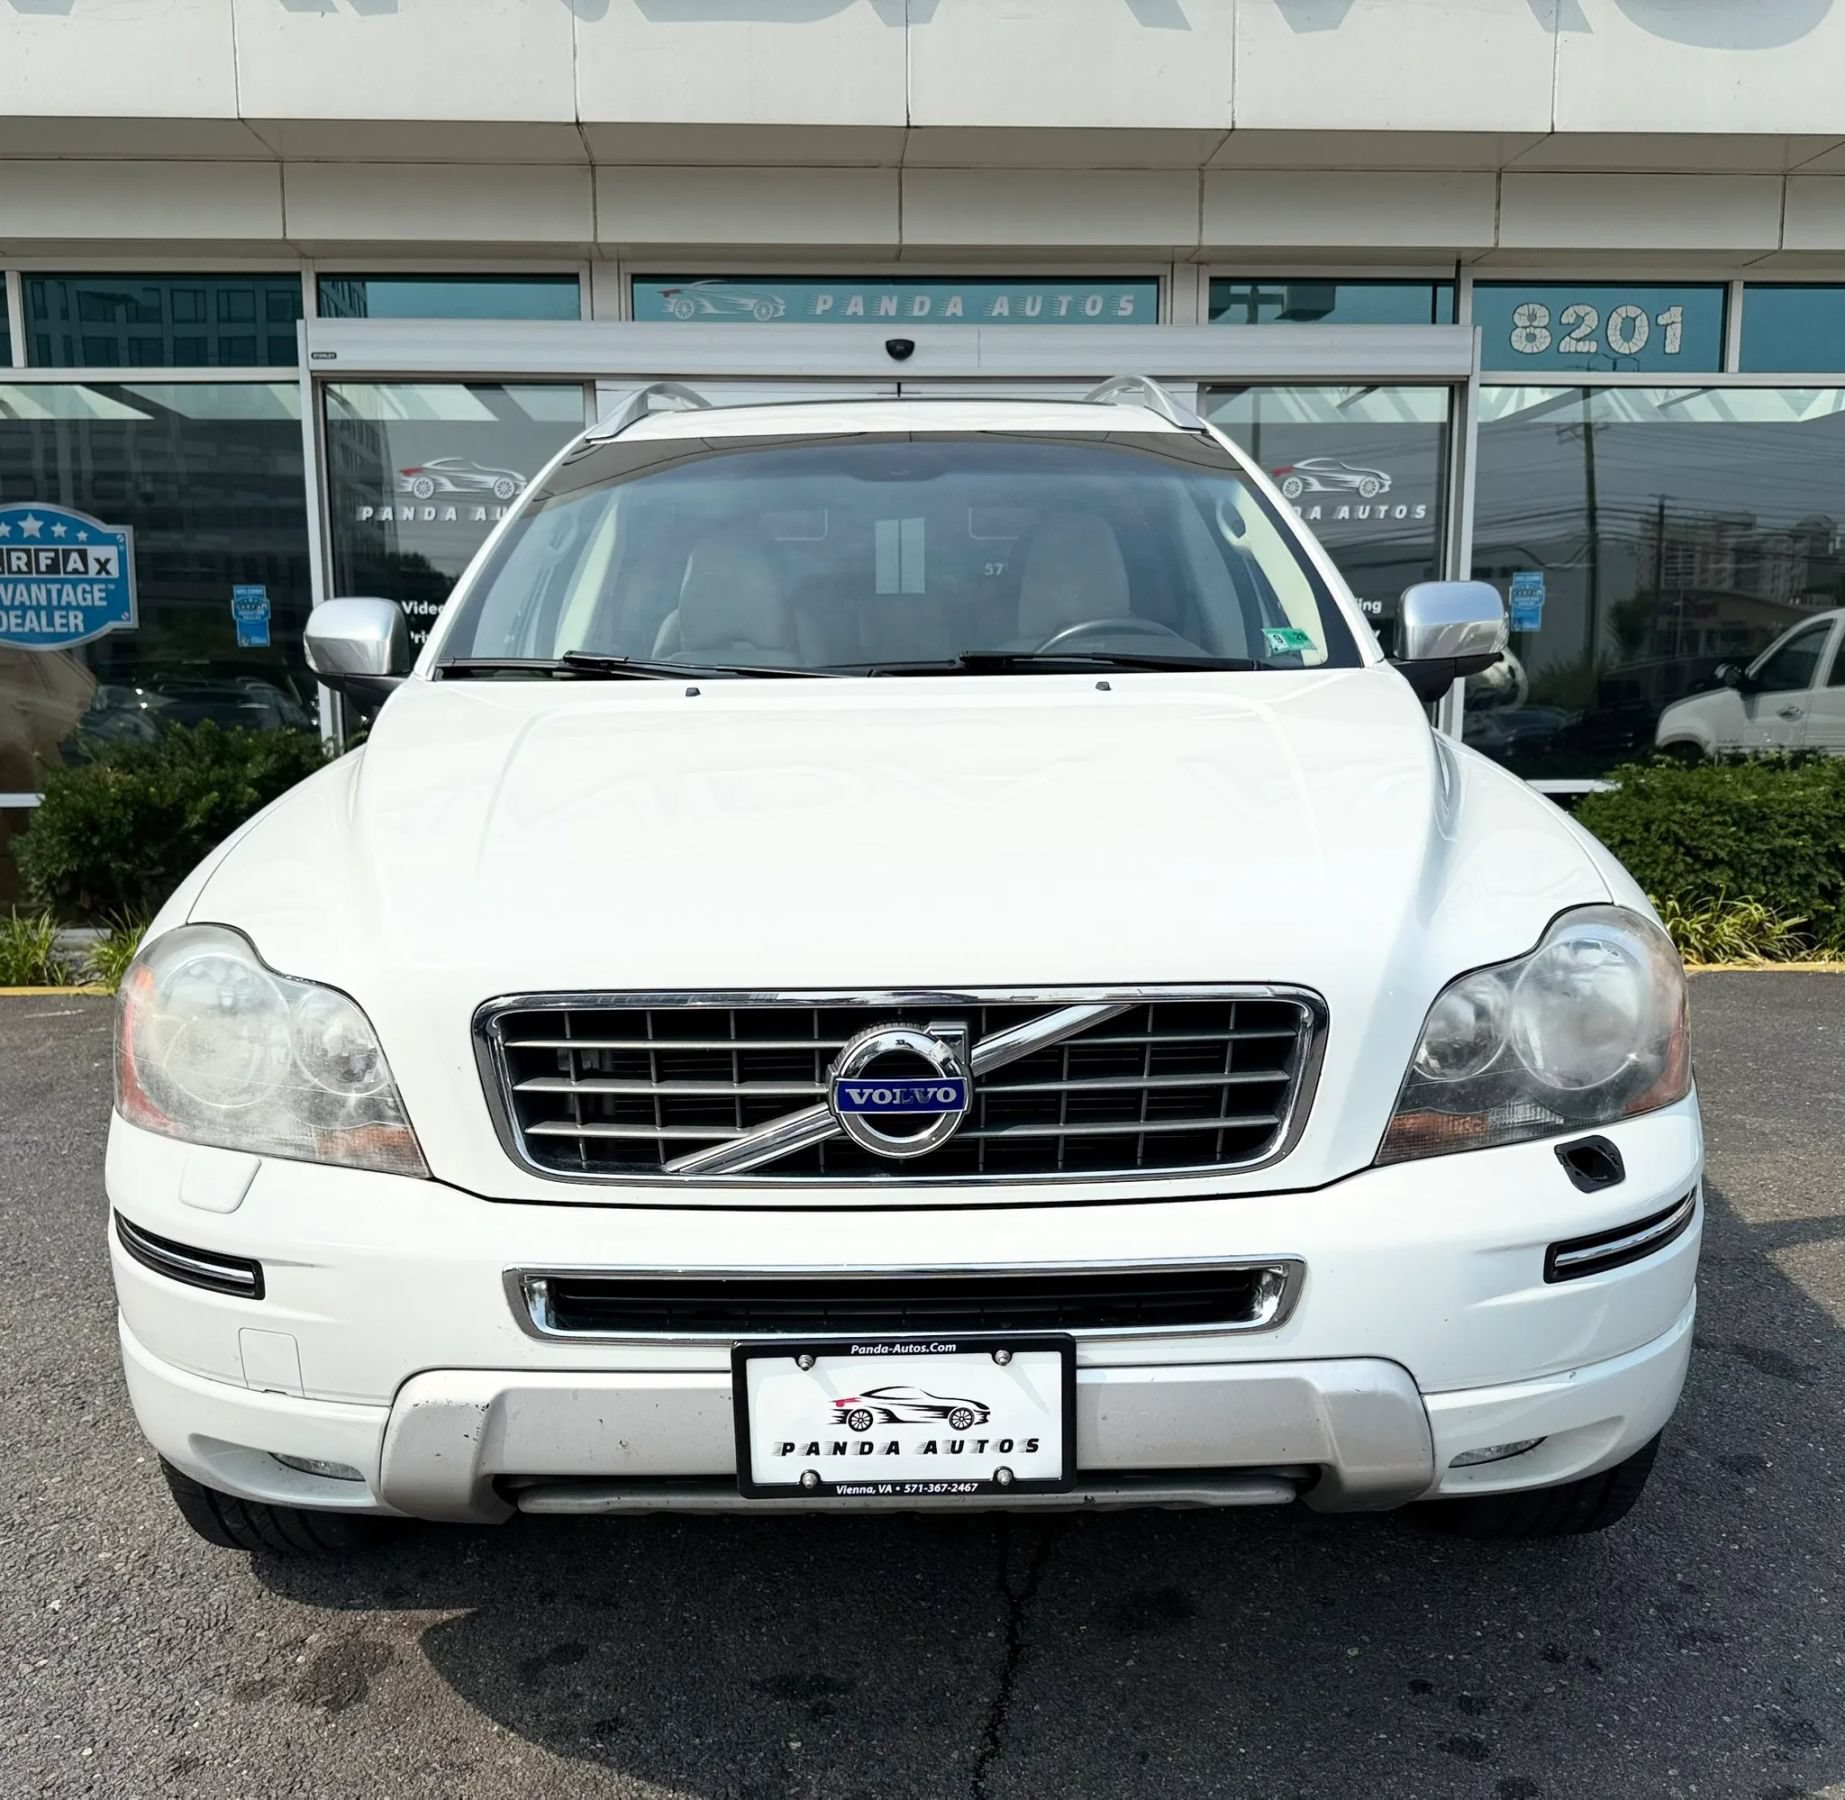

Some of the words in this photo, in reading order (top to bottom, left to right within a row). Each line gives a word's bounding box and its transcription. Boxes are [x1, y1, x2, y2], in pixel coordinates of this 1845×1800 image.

[814, 295, 964, 317] PANDA
[990, 295, 1135, 317] AUTOS
[1509, 302, 1684, 355] 8201
[361, 505, 458, 521] PANDA
[1336, 504, 1427, 520] AUTOS
[0, 550, 114, 577] RFAX
[844, 1086, 957, 1105] VOLVO
[850, 1342, 957, 1355] Panda-Autos.Com
[780, 1440, 901, 1457] PANDA
[922, 1438, 1040, 1455] AUTOS
[836, 1484, 876, 1495] Vienna,
[878, 1483, 893, 1494] VA
[903, 1482, 979, 1493] 571-367-2467
